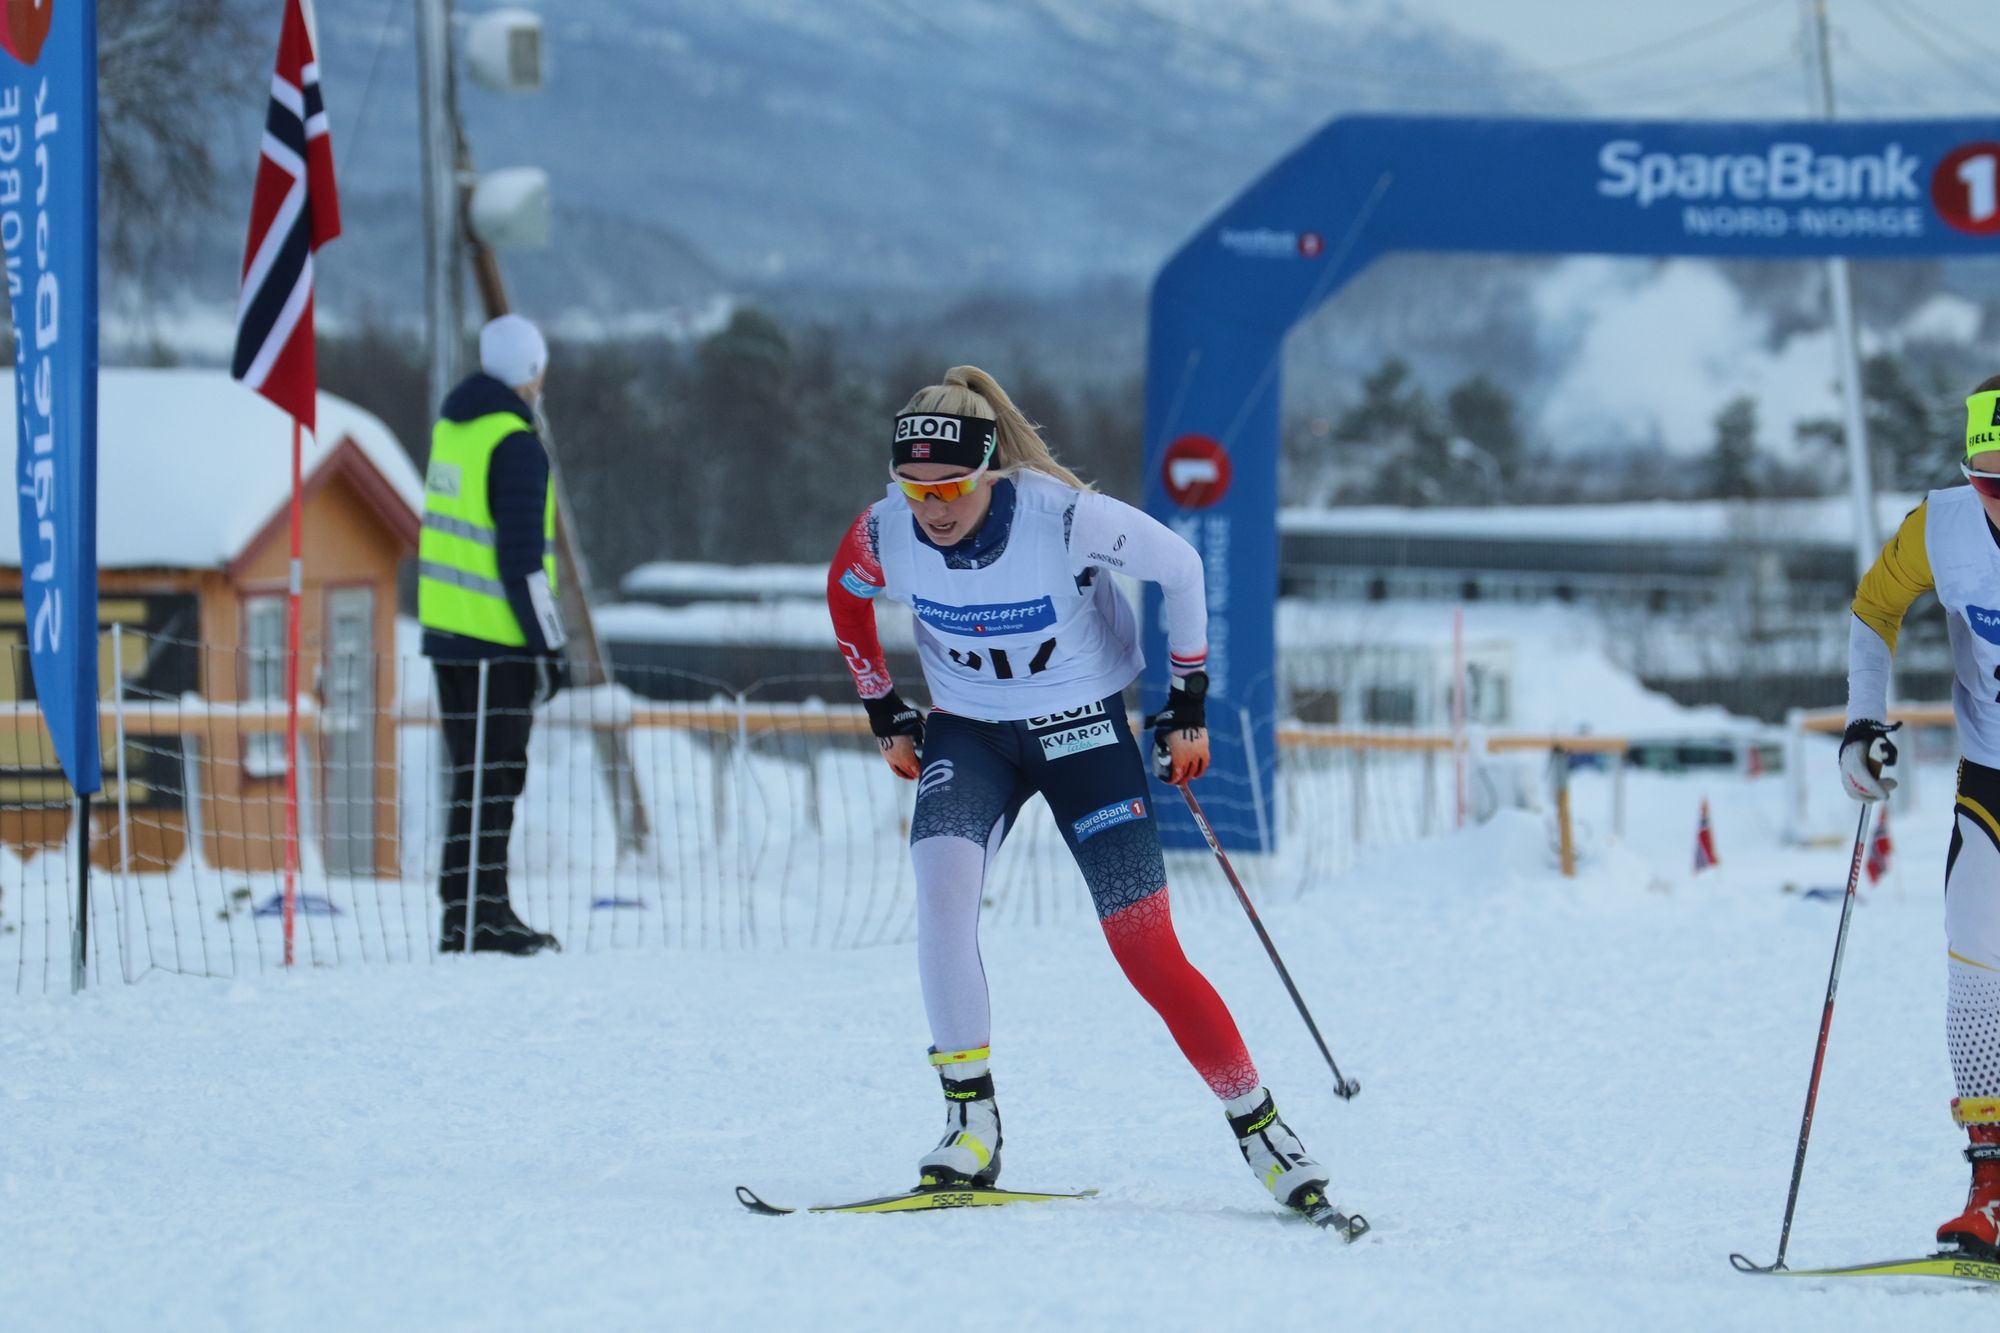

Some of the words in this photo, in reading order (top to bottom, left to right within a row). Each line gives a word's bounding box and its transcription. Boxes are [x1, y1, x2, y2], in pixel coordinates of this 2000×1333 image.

[1598, 140, 1920, 208] SpareBank
[1957, 154, 1997, 222] 1
[916, 604, 1047, 622] SAMFUNNSLØFTET
[1042, 723, 1111, 749] KVARØY
[1074, 804, 1130, 834] SpareBank
[1087, 813, 1132, 834] NORD-NORGE
[931, 1193, 974, 1207] FISCHER
